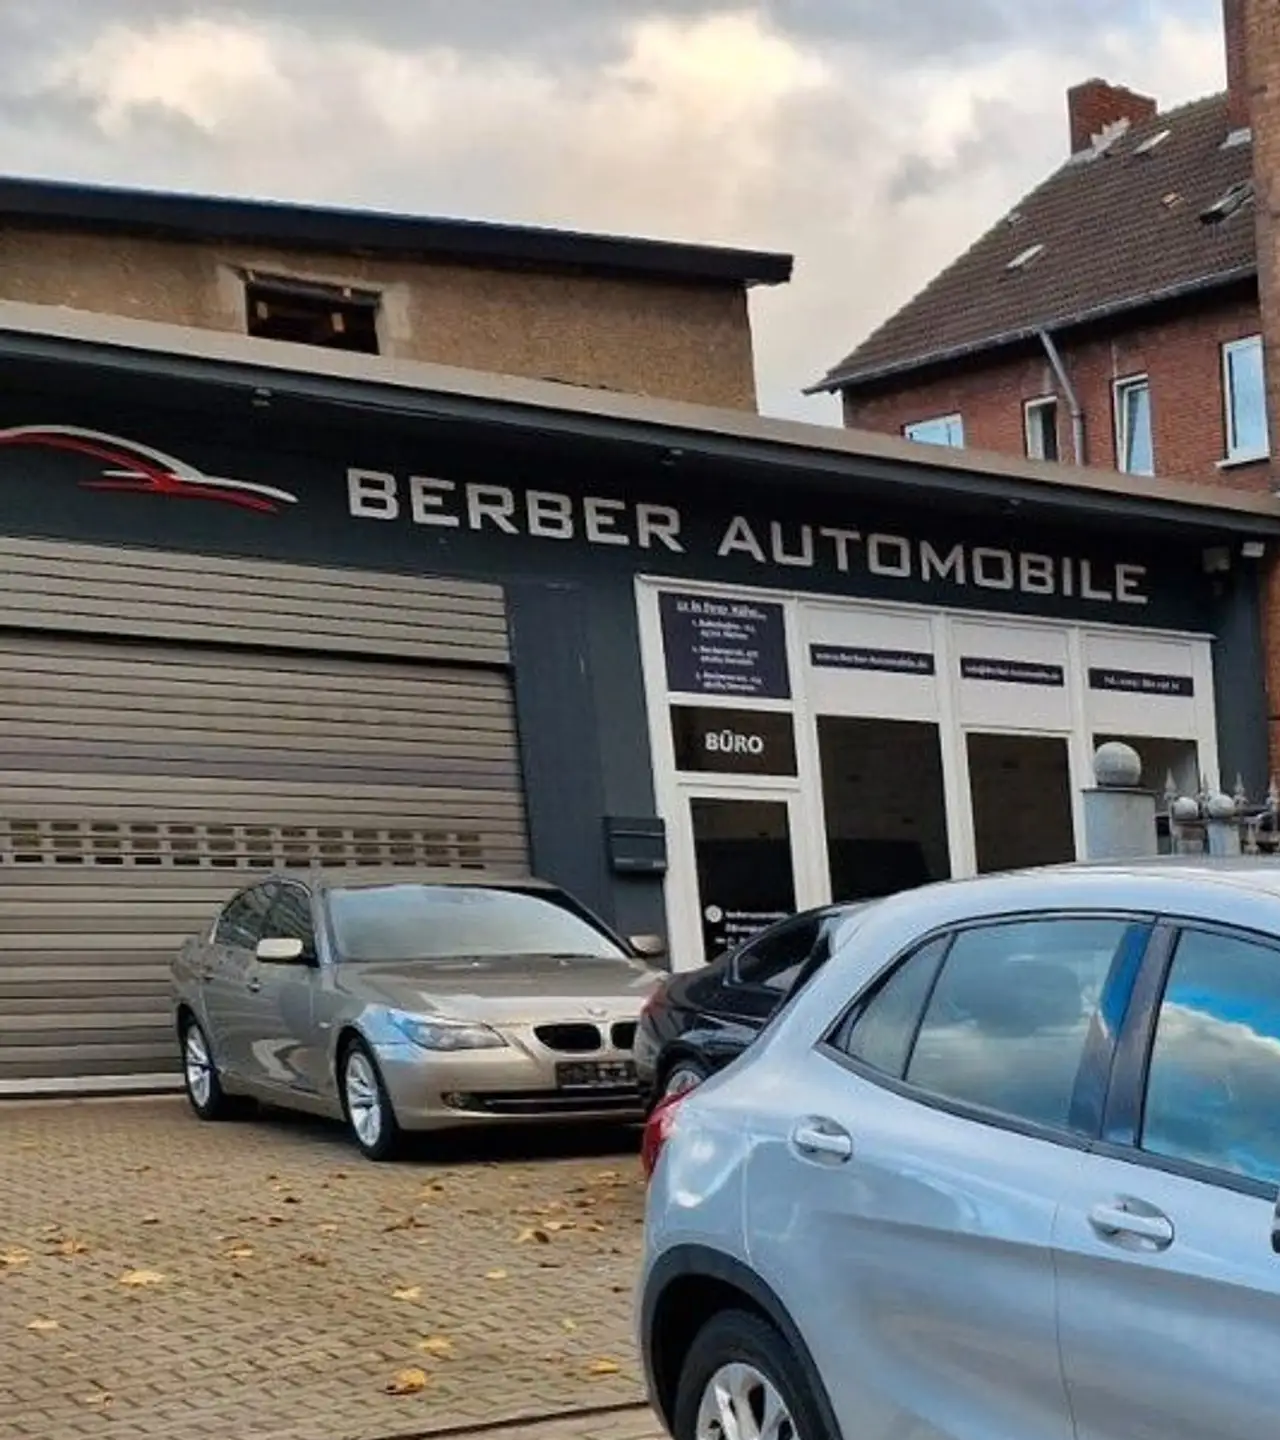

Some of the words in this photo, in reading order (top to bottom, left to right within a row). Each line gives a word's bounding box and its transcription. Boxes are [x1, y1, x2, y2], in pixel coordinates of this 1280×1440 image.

[347, 467, 686, 553] BERBER
[717, 515, 1149, 604] AUTOMOBILE
[705, 729, 764, 755] BÜRO
